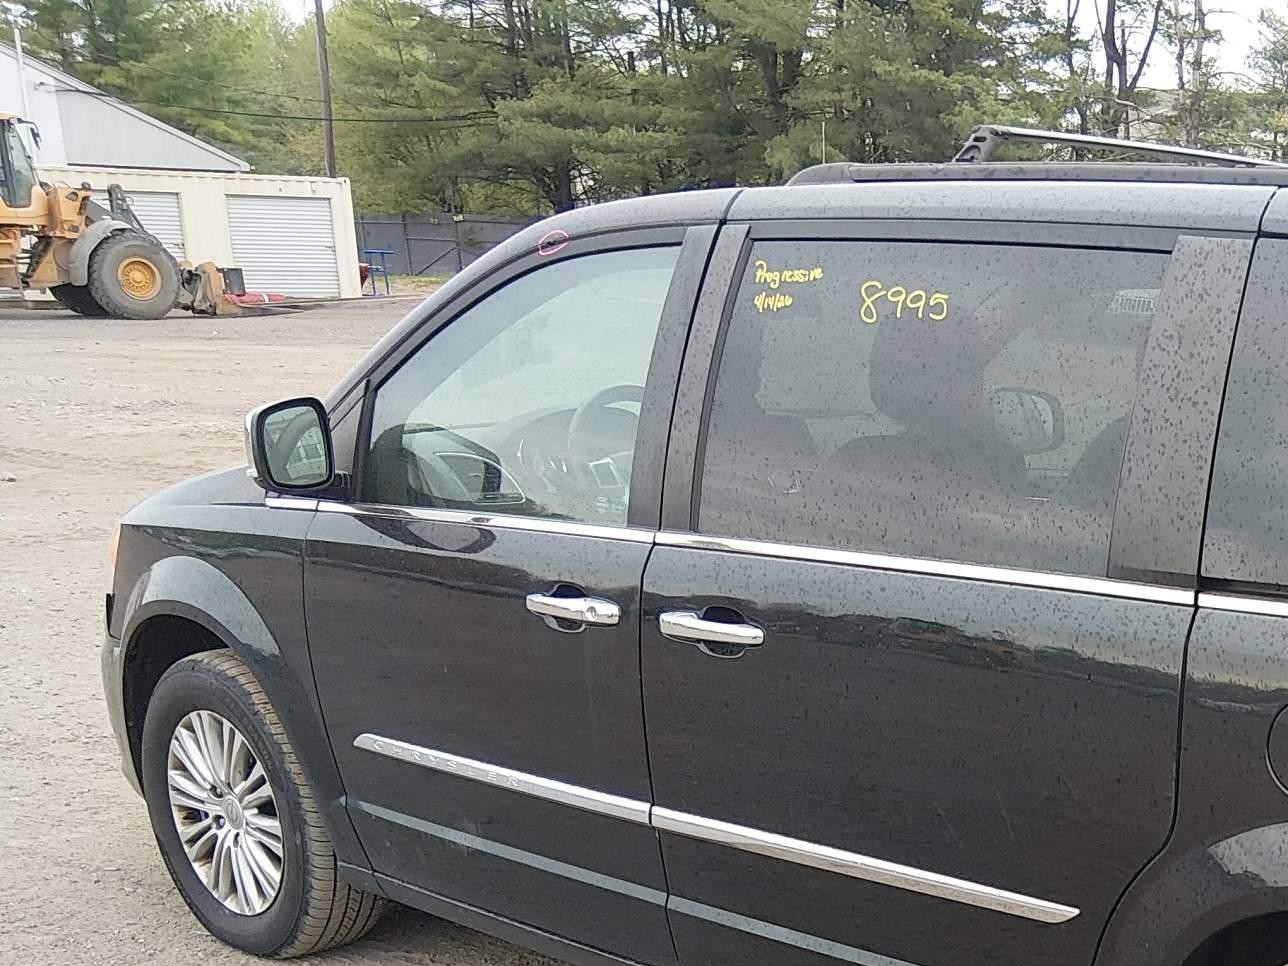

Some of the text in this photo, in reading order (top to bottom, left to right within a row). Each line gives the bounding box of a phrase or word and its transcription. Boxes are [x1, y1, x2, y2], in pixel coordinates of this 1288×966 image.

[754, 260, 824, 289] Progressive
[860, 280, 950, 324] 8995
[374, 740, 520, 787] CHRYSLER
